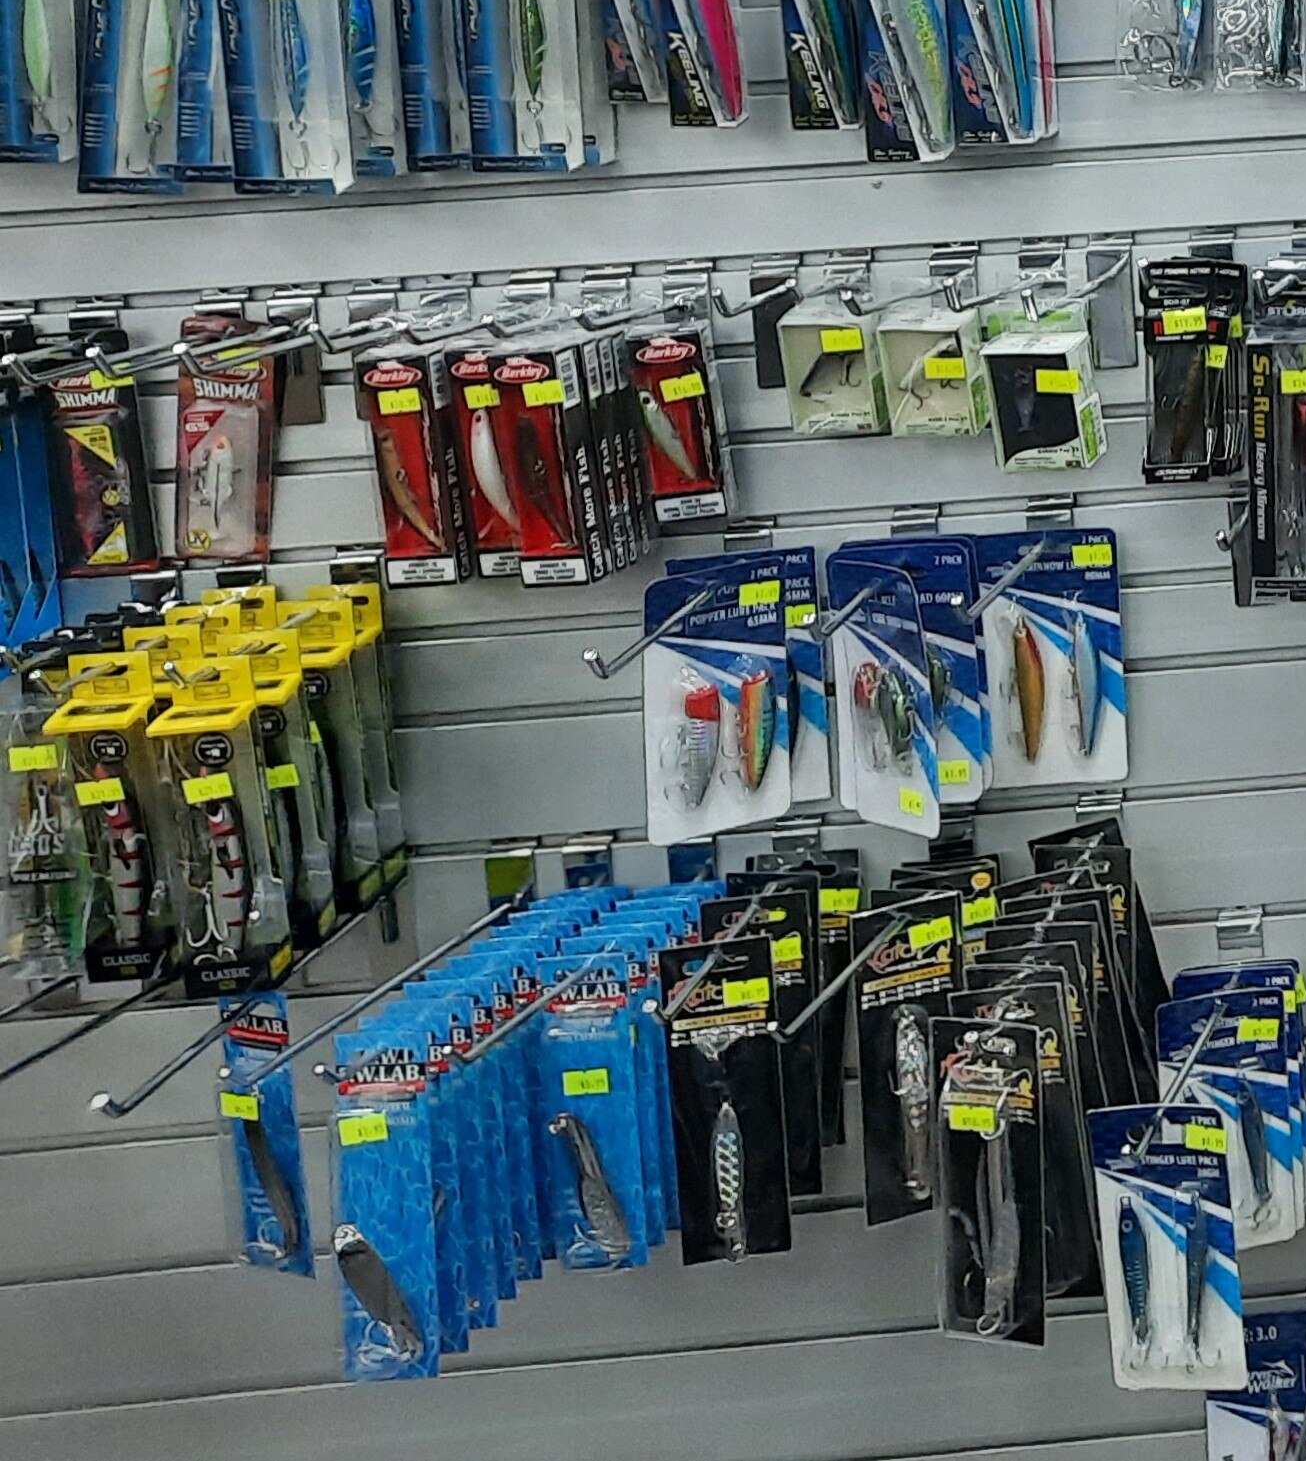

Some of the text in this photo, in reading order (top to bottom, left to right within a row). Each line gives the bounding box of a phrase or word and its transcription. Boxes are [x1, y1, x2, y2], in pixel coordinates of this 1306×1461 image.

[667, 32, 708, 107] KEELING
[789, 32, 830, 111] KEELING
[644, 346, 689, 360] Berkley
[499, 365, 544, 380] Berkley
[55, 389, 118, 408] SHIMMA
[192, 378, 259, 400] SHIMMA
[1253, 354, 1270, 439] So-Run
[1254, 442, 1267, 485] Heavy
[575, 446, 605, 578] Catch More Fish
[103, 954, 151, 966] CLASSIC
[201, 967, 250, 981] CLASSIC
[341, 1065, 425, 1083] .W.LAB.
[1256, 1326, 1277, 1340] 3.0
